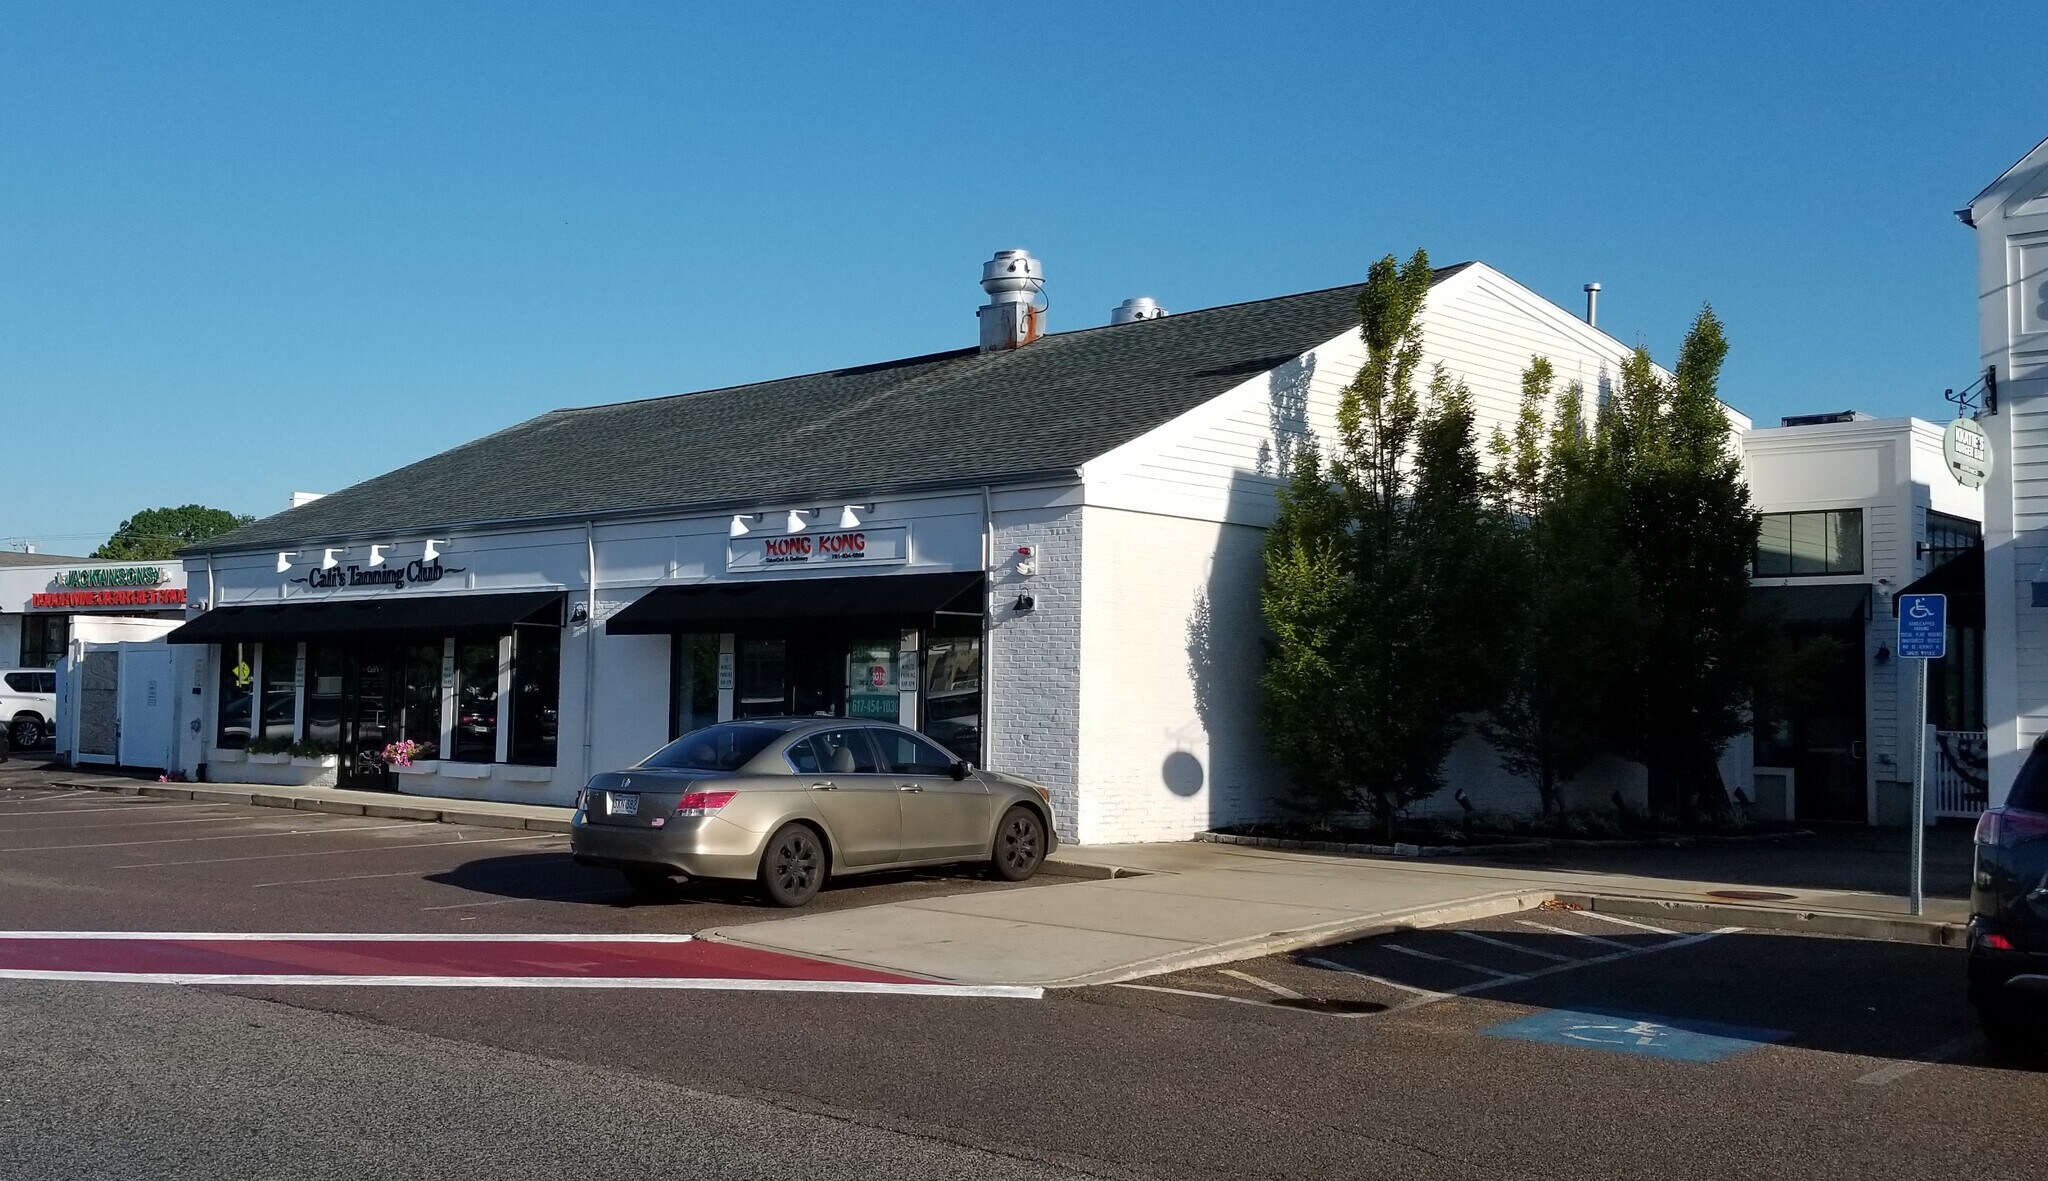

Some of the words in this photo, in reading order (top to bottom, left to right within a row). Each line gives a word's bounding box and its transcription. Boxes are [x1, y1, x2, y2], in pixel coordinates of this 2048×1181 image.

[765, 537, 811, 556] HONG
[819, 533, 865, 553] KONG
[309, 567, 346, 588] Cali's
[347, 564, 405, 589] Tanning
[407, 557, 443, 582] Club
